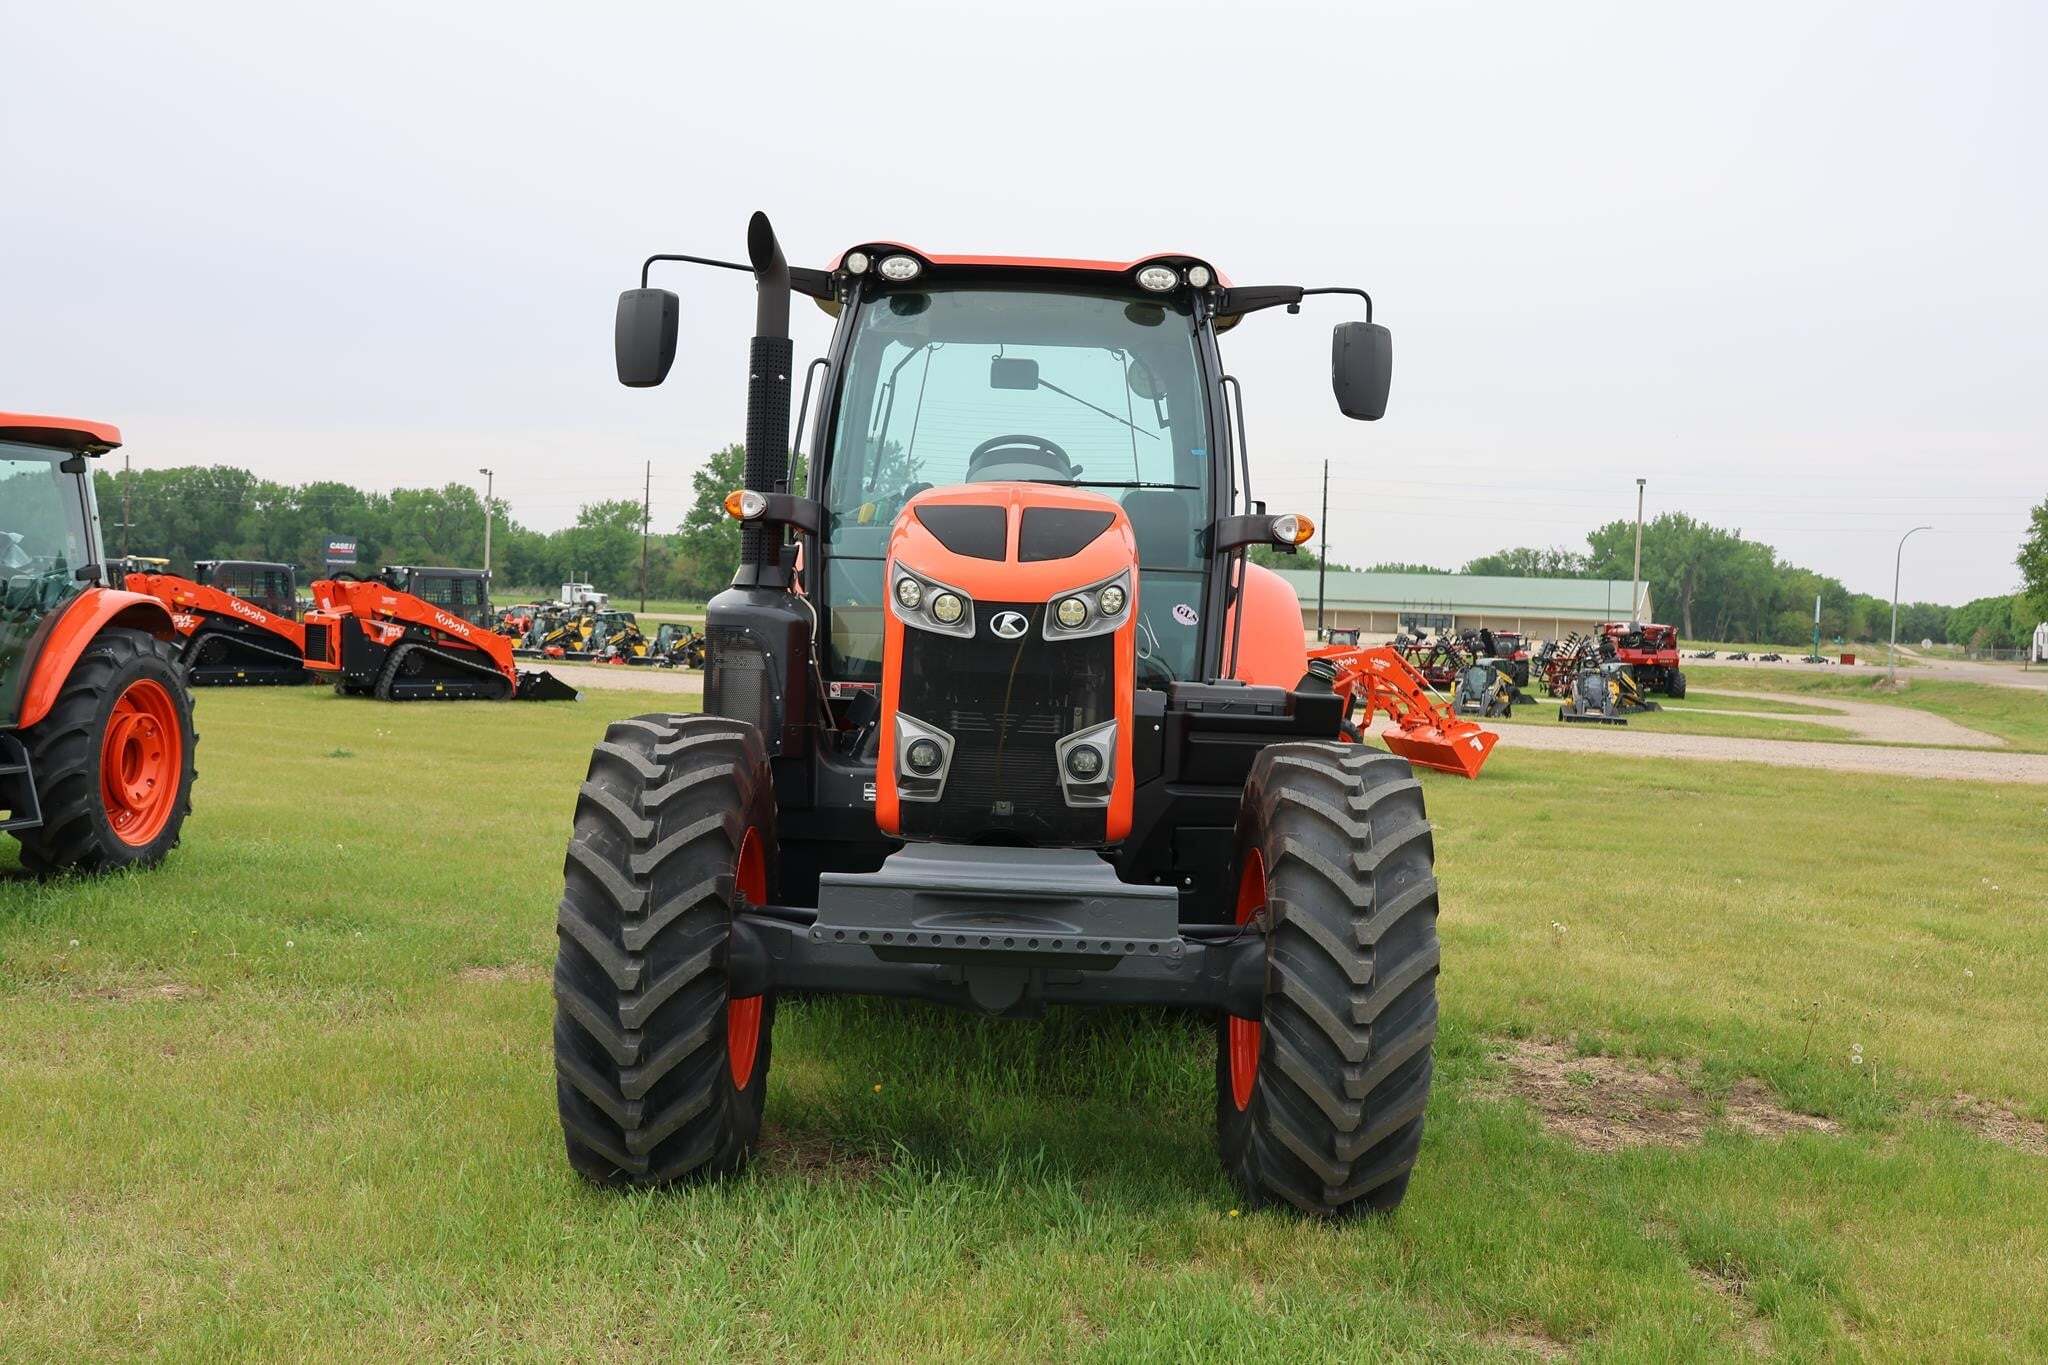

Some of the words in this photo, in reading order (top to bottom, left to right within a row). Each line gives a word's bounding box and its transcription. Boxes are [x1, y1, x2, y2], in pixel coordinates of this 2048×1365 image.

[230, 600, 267, 623] Kubota
[1176, 606, 1198, 622] GLS
[435, 611, 470, 637] Kubota
